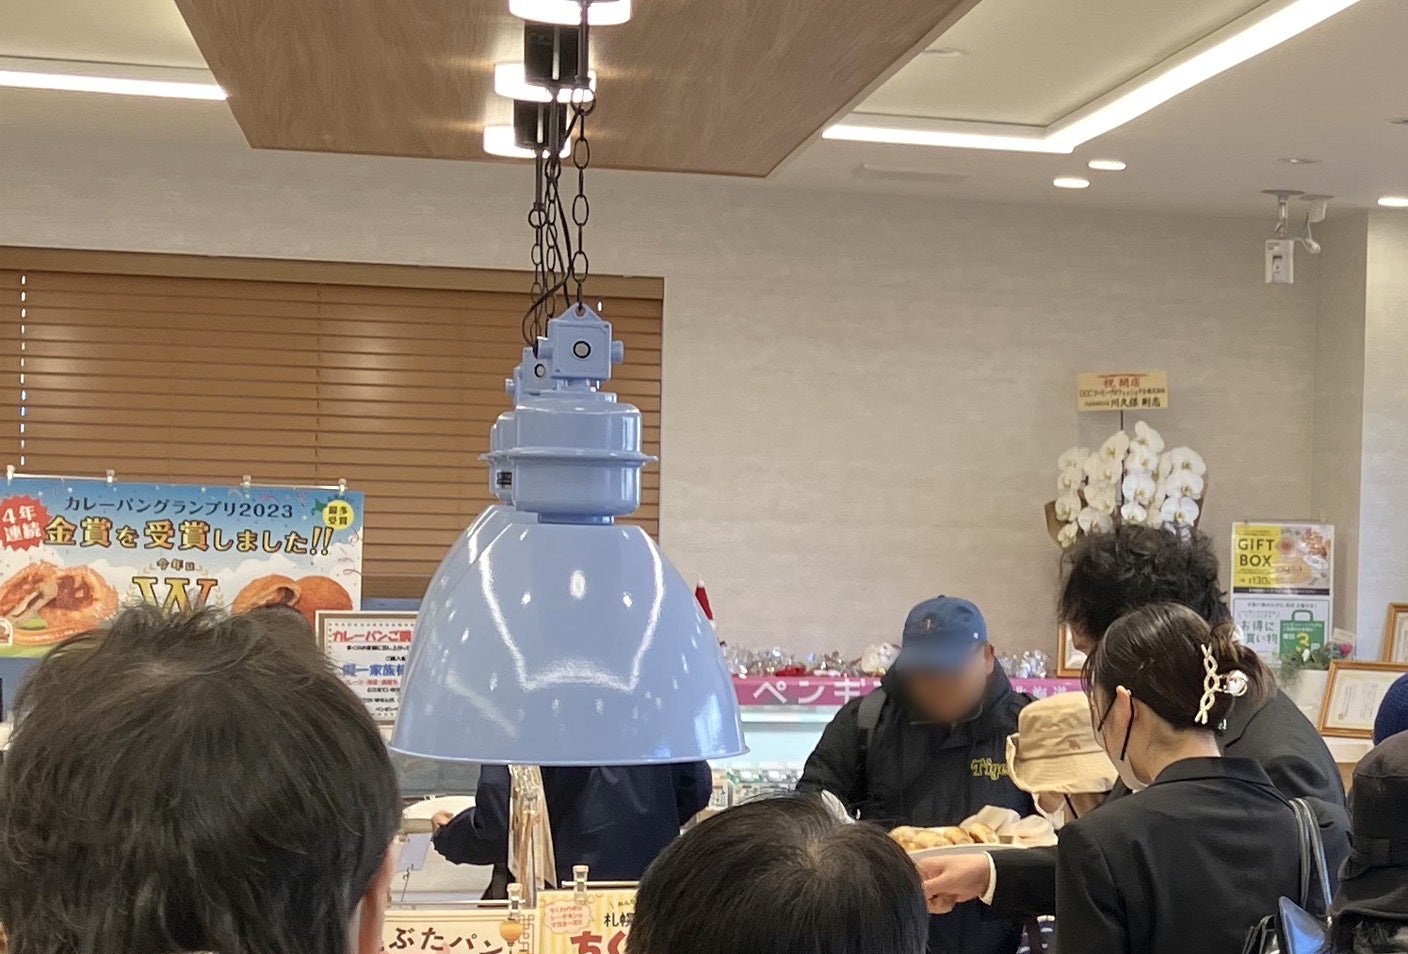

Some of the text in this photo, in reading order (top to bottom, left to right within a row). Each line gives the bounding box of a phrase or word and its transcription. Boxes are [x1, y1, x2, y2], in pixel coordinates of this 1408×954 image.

[2, 505, 37, 525] 4年
[65, 496, 293, 519] カレーパングランプリ2023
[328, 516, 348, 526] 受賞
[5, 521, 42, 543] 連続
[1238, 538, 1275, 551] GIFT
[1239, 554, 1272, 567] BOX
